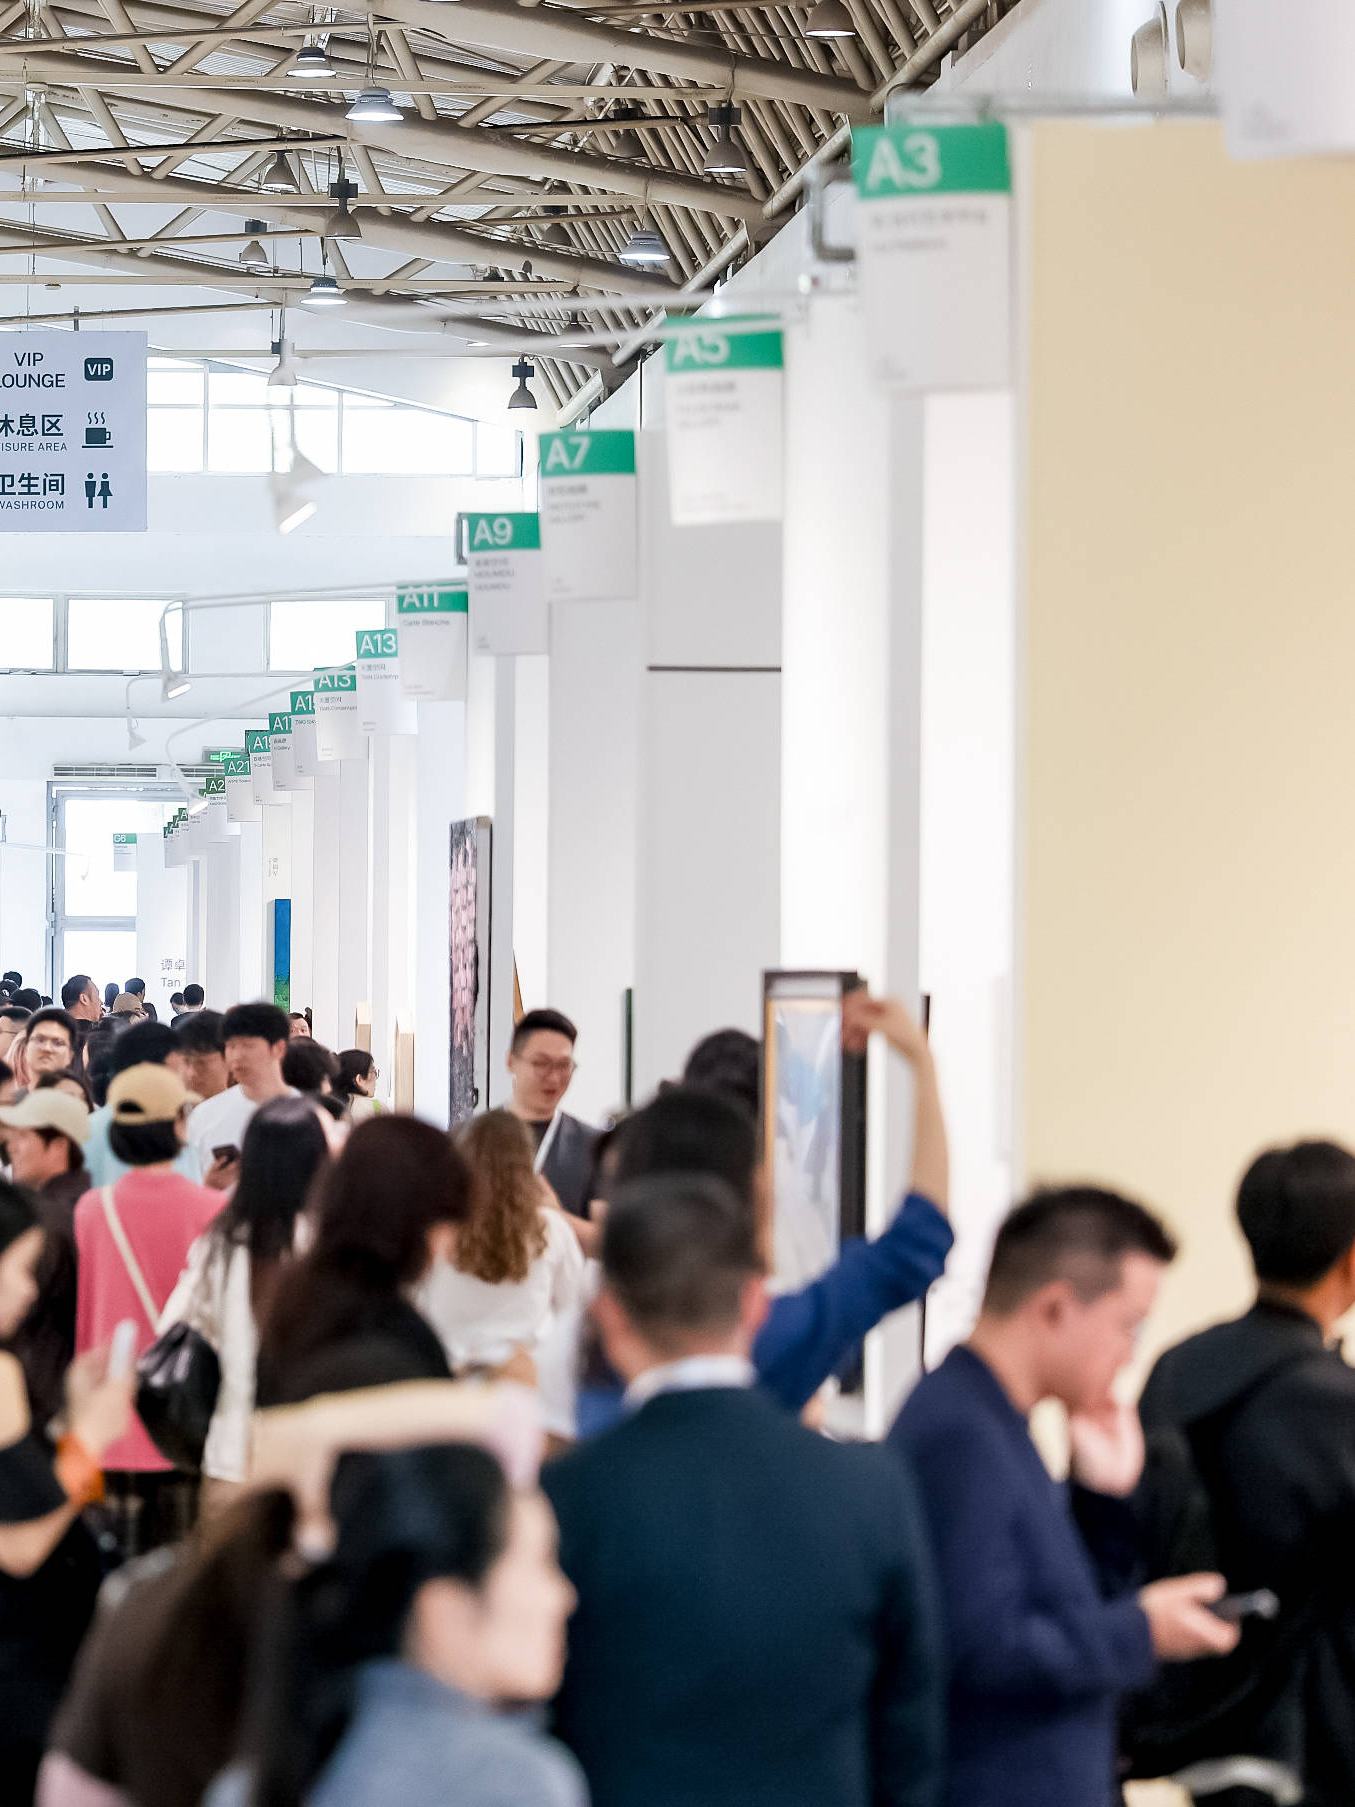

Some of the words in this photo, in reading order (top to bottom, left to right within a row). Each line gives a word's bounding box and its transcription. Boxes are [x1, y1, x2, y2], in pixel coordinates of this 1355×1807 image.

[865, 132, 942, 189] A3
[672, 329, 731, 365] A5
[13, 352, 45, 367] VIP
[87, 363, 112, 376] VIP
[37, 442, 68, 452] AREA
[545, 435, 592, 471] A7
[473, 517, 514, 546] A9
[359, 633, 397, 654] A13
[318, 674, 352, 689] A13
[294, 694, 315, 711] A1
[273, 715, 292, 731] A1
[253, 735, 270, 750] A1
[227, 760, 250, 773] A21
[160, 958, 186, 971] 谭卓
[160, 977, 181, 988] Tan
